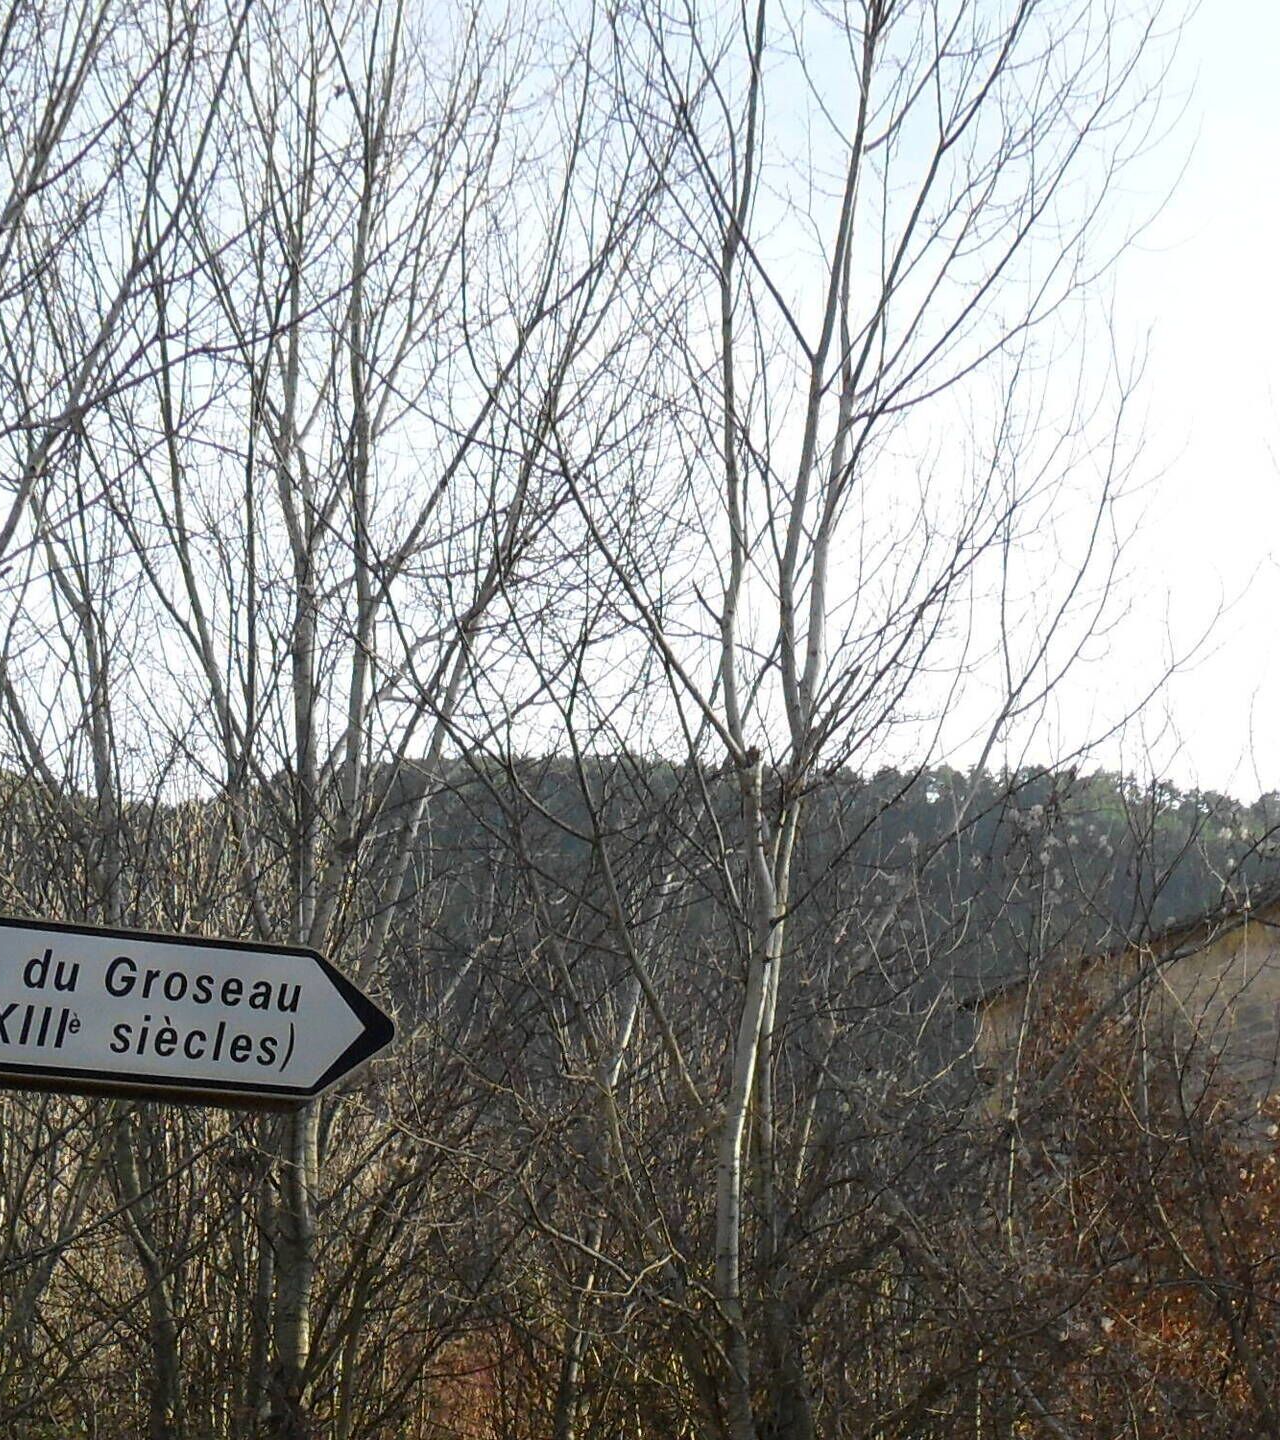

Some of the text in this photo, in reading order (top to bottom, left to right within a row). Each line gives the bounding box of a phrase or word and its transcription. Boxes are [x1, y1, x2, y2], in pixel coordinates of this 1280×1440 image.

[22, 948, 81, 993] du
[104, 956, 302, 1014] Groseau
[109, 1014, 295, 1073] siècles)
